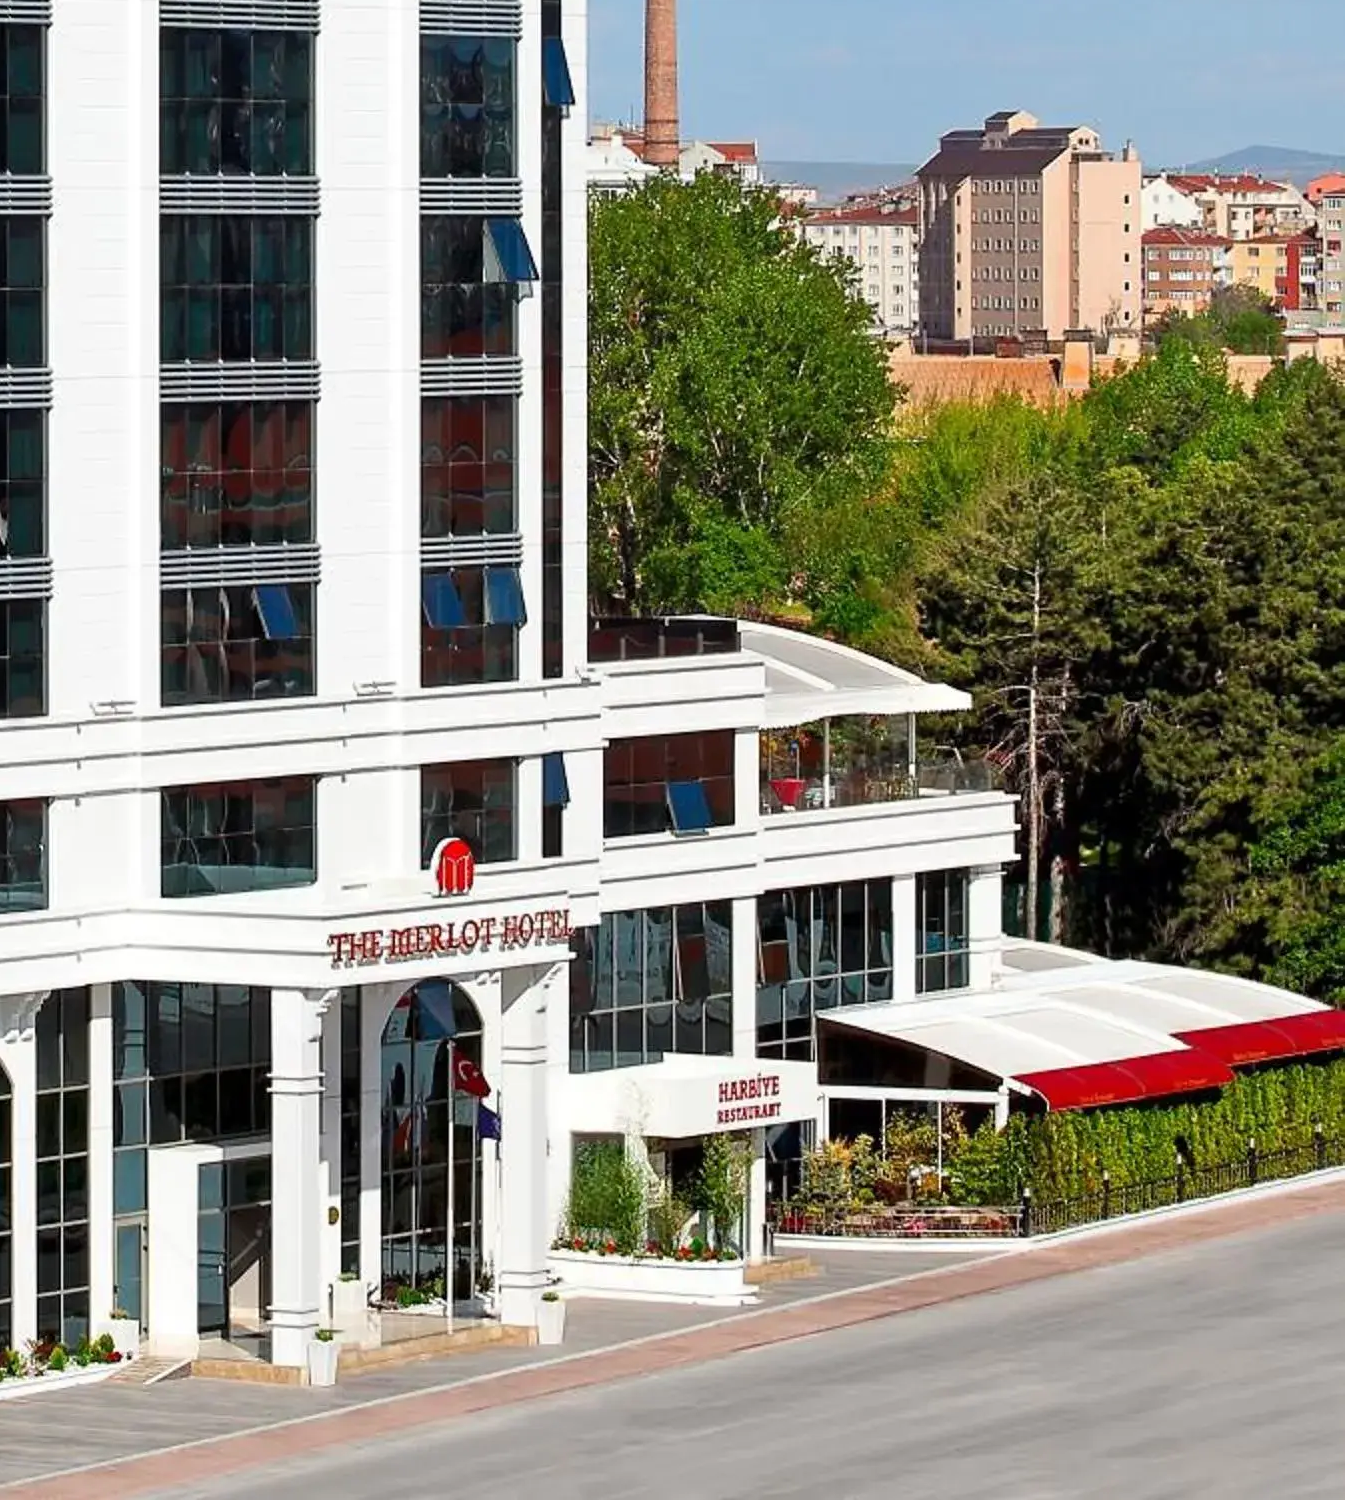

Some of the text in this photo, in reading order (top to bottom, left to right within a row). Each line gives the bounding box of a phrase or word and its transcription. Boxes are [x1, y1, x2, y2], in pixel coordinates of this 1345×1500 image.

[328, 908, 575, 962] THE MERLOT HOTEL
[718, 1073, 780, 1103] HARBİYE
[717, 1102, 782, 1124] RESTAURANT
